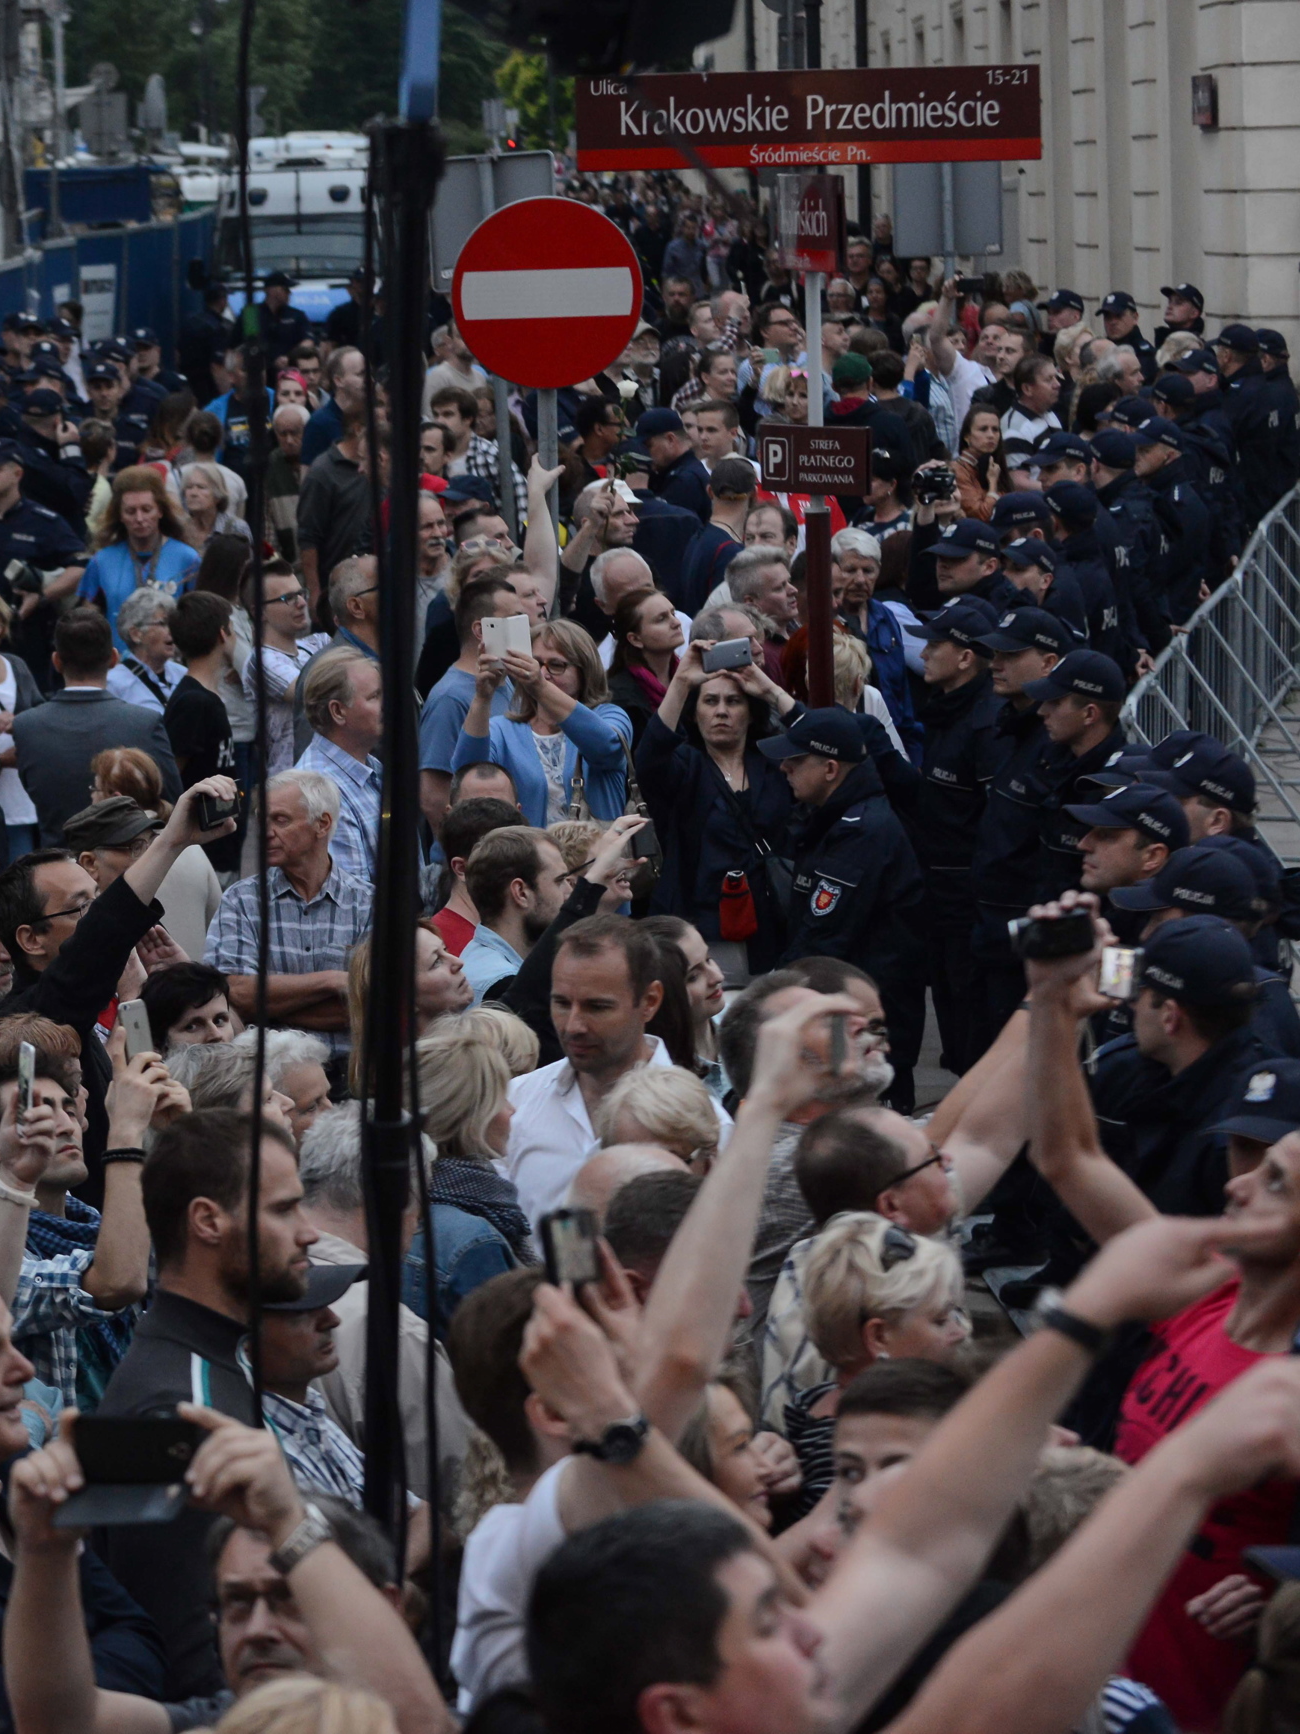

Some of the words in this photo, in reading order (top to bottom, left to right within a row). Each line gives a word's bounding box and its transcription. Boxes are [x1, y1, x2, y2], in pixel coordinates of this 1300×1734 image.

[985, 69, 1029, 86] 15-21
[589, 79, 629, 97] Ulica
[619, 93, 789, 136] Krakowskie
[805, 90, 1001, 131] Przedmieście
[749, 144, 841, 165] Śródmieście
[847, 145, 871, 162] Pn.
[809, 439, 841, 451] STREFA
[799, 454, 855, 469] PŁATNEGO
[799, 472, 855, 485] PARKOWANIA
[1012, 510, 1037, 521] POLICJA
[1035, 633, 1060, 649] POLICJA
[1072, 678, 1104, 694] POLICJA
[809, 740, 839, 756] POLICJA
[932, 766, 958, 783] POLICJA
[1200, 778, 1235, 801] POLICJA
[1137, 811, 1172, 838] POLICJA
[1172, 886, 1217, 906] POLICJA
